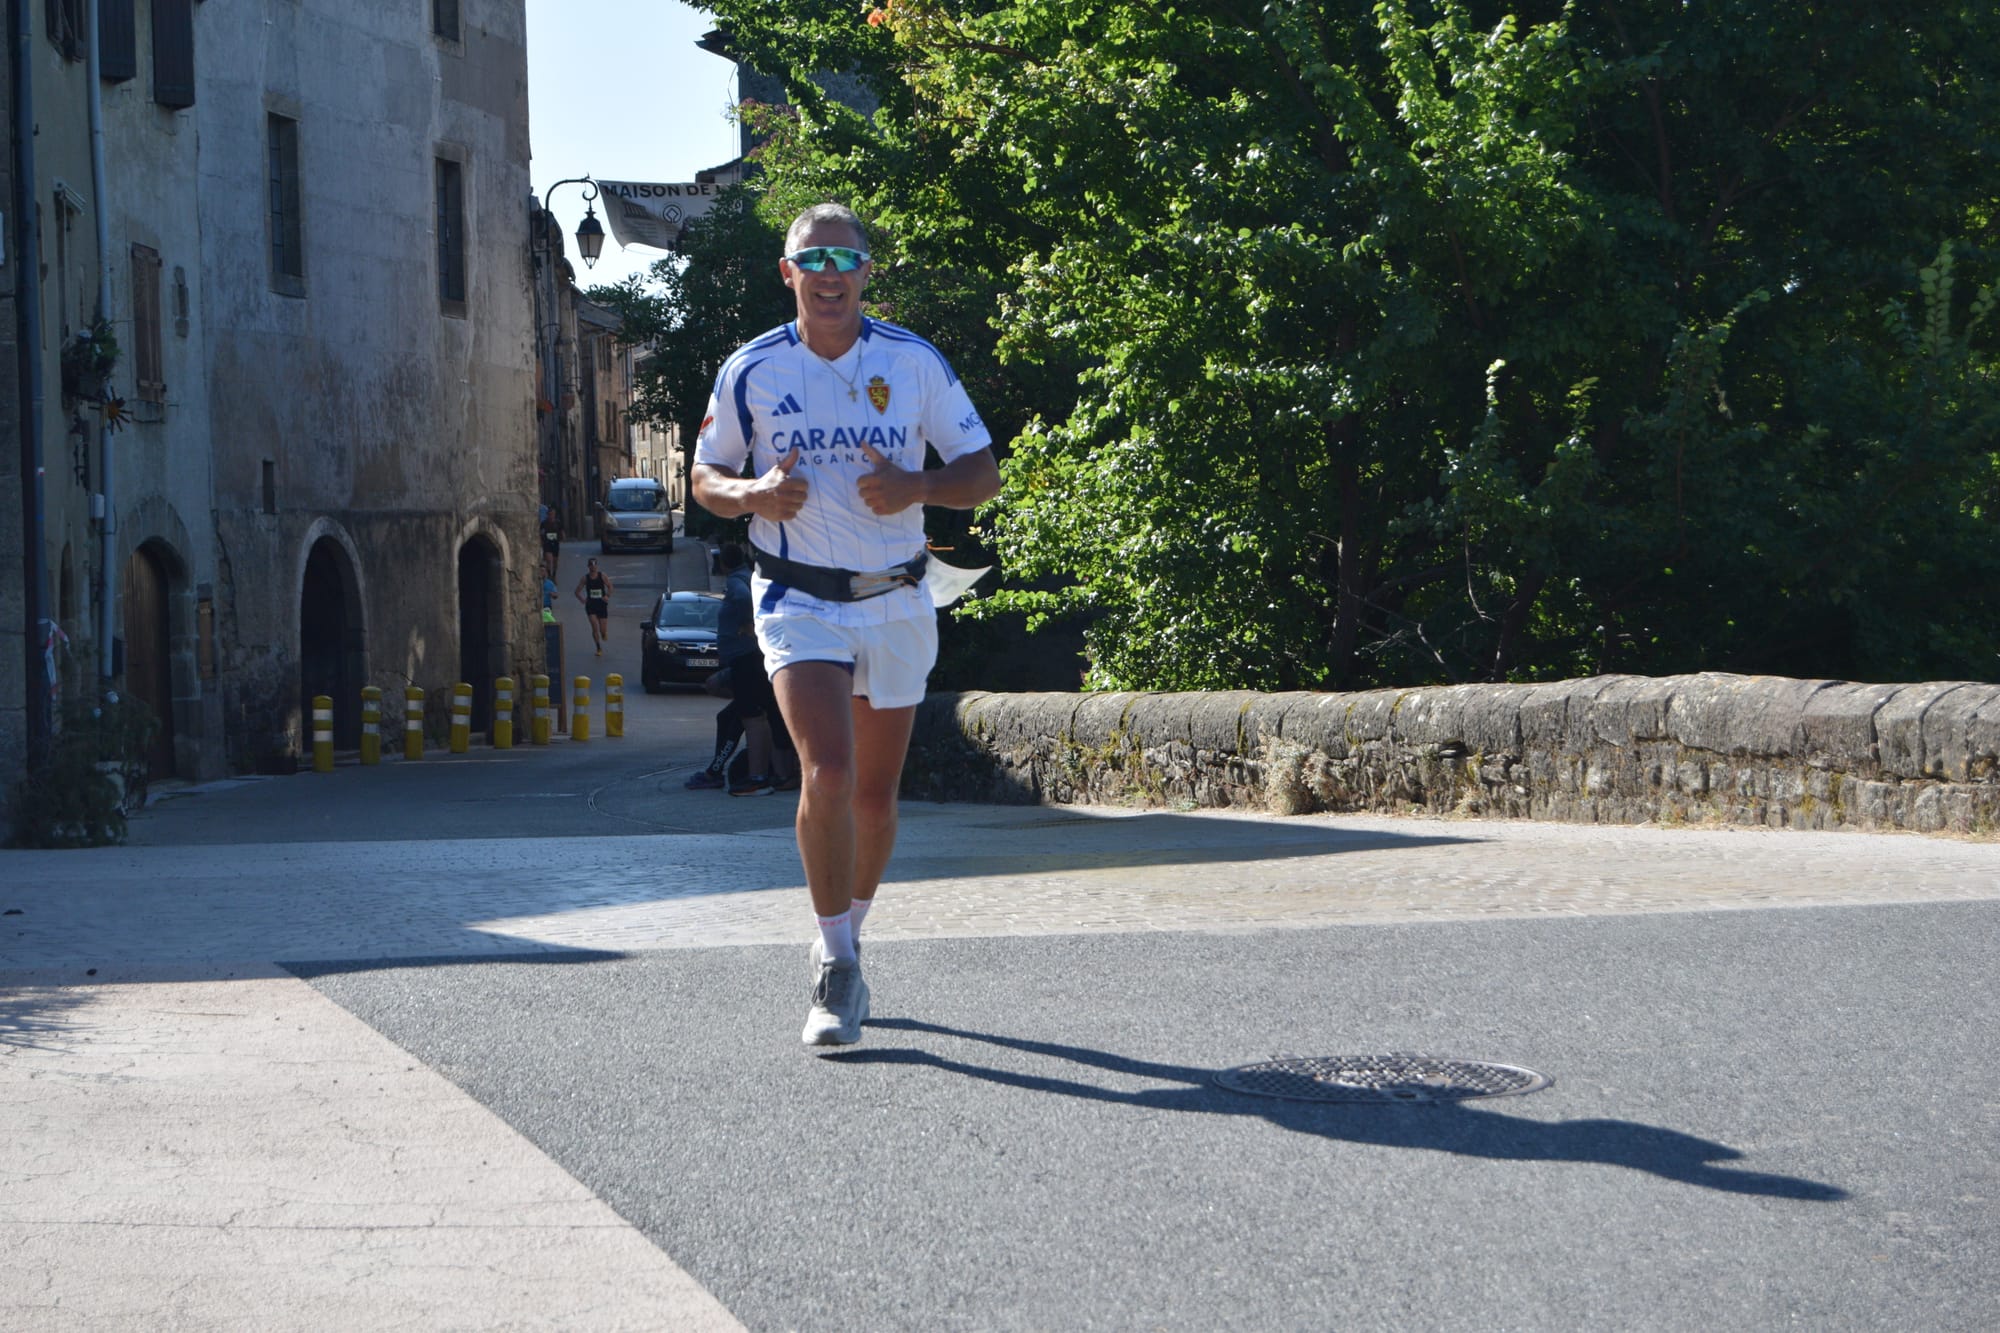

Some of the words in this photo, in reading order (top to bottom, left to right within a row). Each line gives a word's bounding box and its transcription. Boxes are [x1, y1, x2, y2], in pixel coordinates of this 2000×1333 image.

[603, 184, 681, 199] MAISON
[686, 184, 711, 197] DE
[771, 426, 907, 453] CARAVAN
[712, 740, 734, 772] adidas
